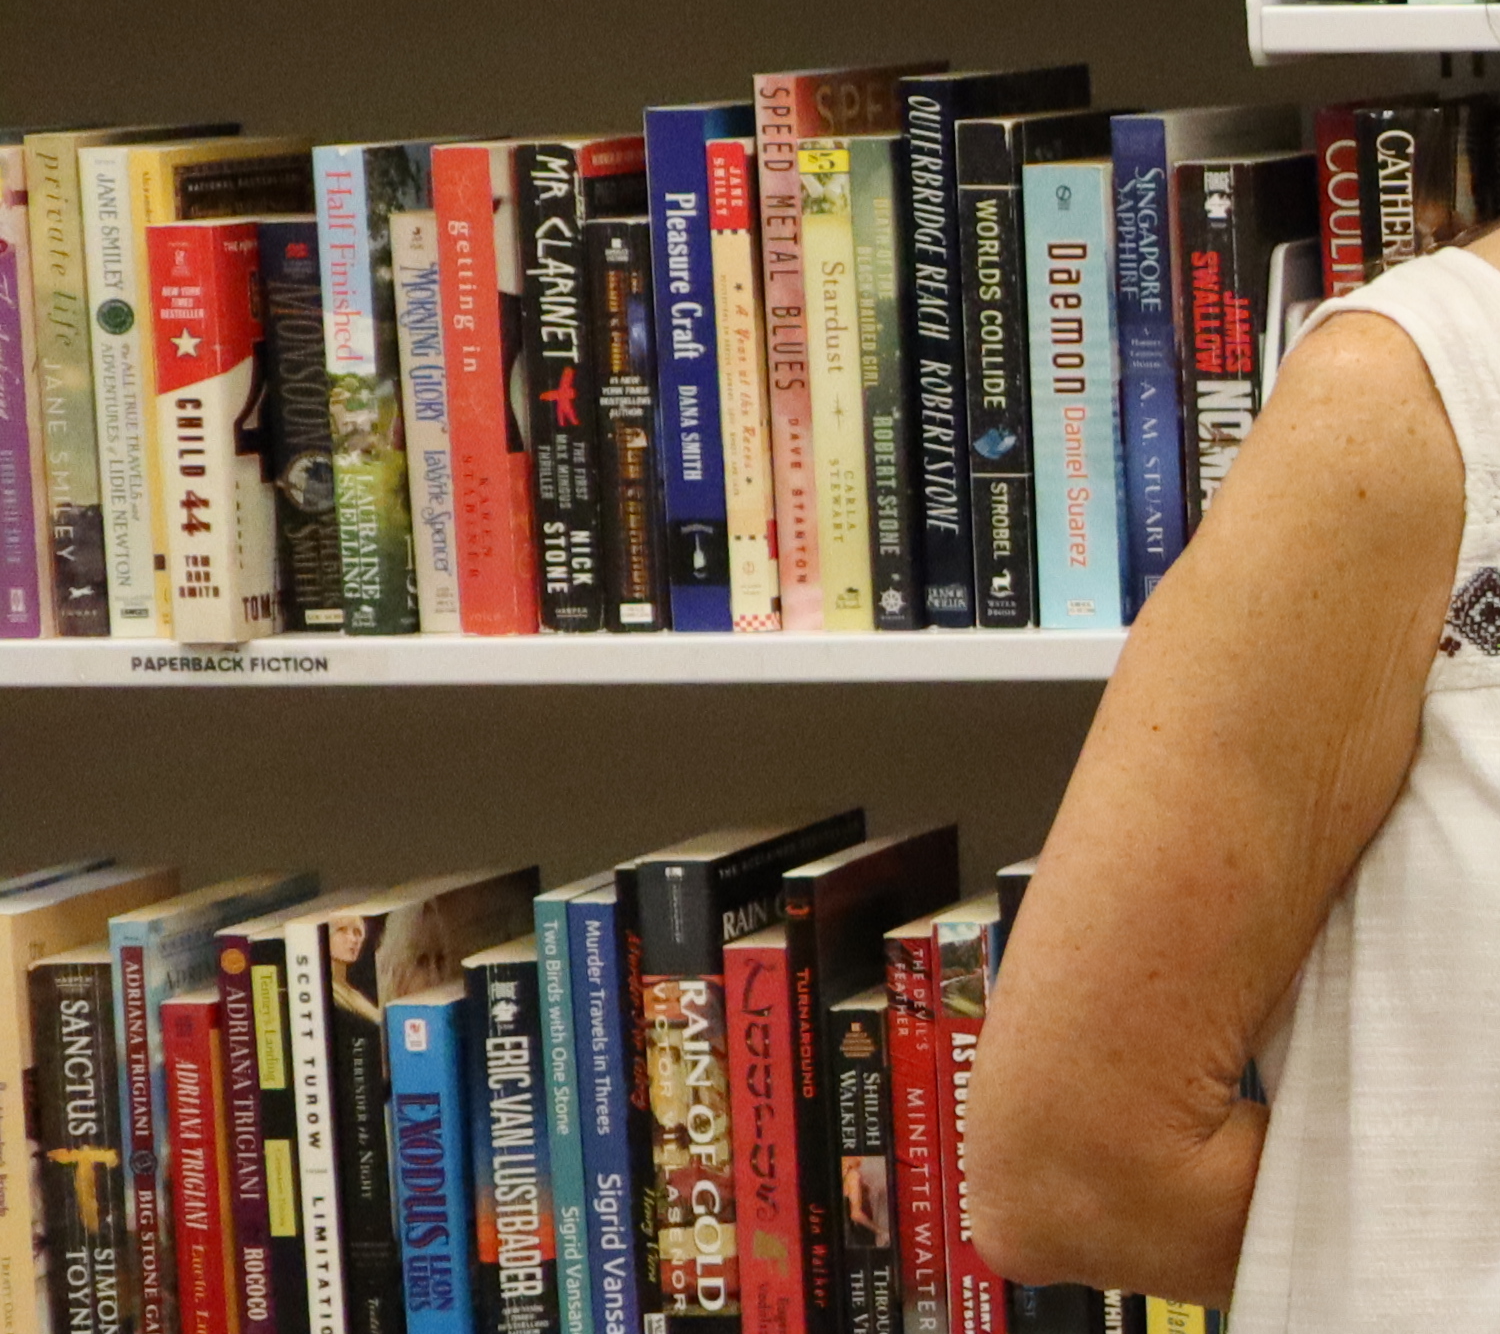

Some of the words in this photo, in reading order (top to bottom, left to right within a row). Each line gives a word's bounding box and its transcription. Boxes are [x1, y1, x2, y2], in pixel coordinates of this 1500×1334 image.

[529, 153, 570, 209] MR.
[662, 192, 695, 293] Pleasure
[975, 198, 999, 302] WORLDS
[527, 216, 580, 365] CLARINET
[670, 301, 705, 361] Craft
[1047, 241, 1089, 395] Daemon
[979, 307, 1006, 410] COLLIDE
[676, 384, 699, 431] DANA
[1061, 406, 1086, 476] Daniel
[678, 431, 703, 481] SMITH
[1064, 481, 1093, 570] Suarez
[131, 655, 245, 673] PAPERBACK
[250, 656, 328, 673] FICTION
[296, 956, 317, 1040] SCOTT
[676, 977, 713, 1087] RAIN
[303, 1058, 322, 1150] TUROW
[686, 1095, 718, 1172] OF
[596, 1173, 622, 1258] Sigrid
[689, 1179, 728, 1313] GOLD
